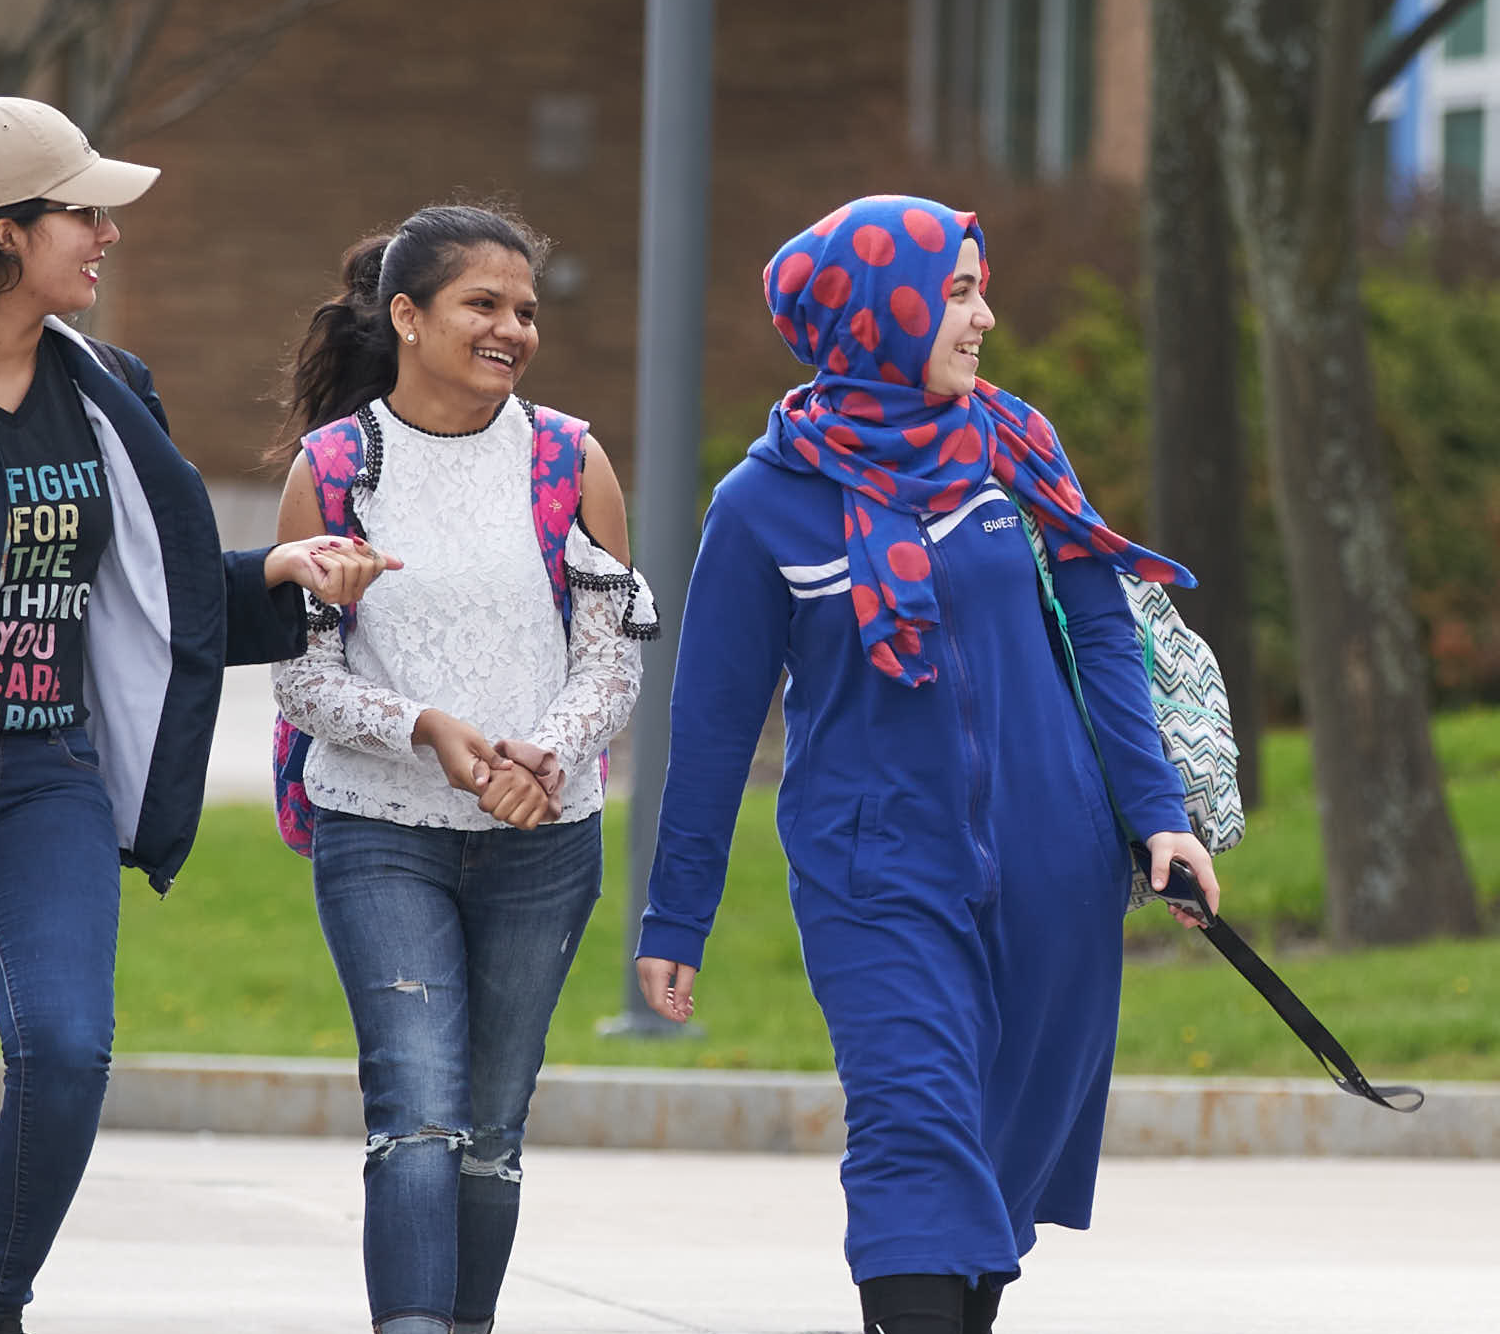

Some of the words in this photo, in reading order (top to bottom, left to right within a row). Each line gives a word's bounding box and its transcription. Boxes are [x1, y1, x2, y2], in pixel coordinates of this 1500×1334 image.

[5, 460, 101, 503] FIGHT
[12, 503, 80, 544] FOR
[11, 543, 77, 580] THE
[0, 582, 91, 620] THING
